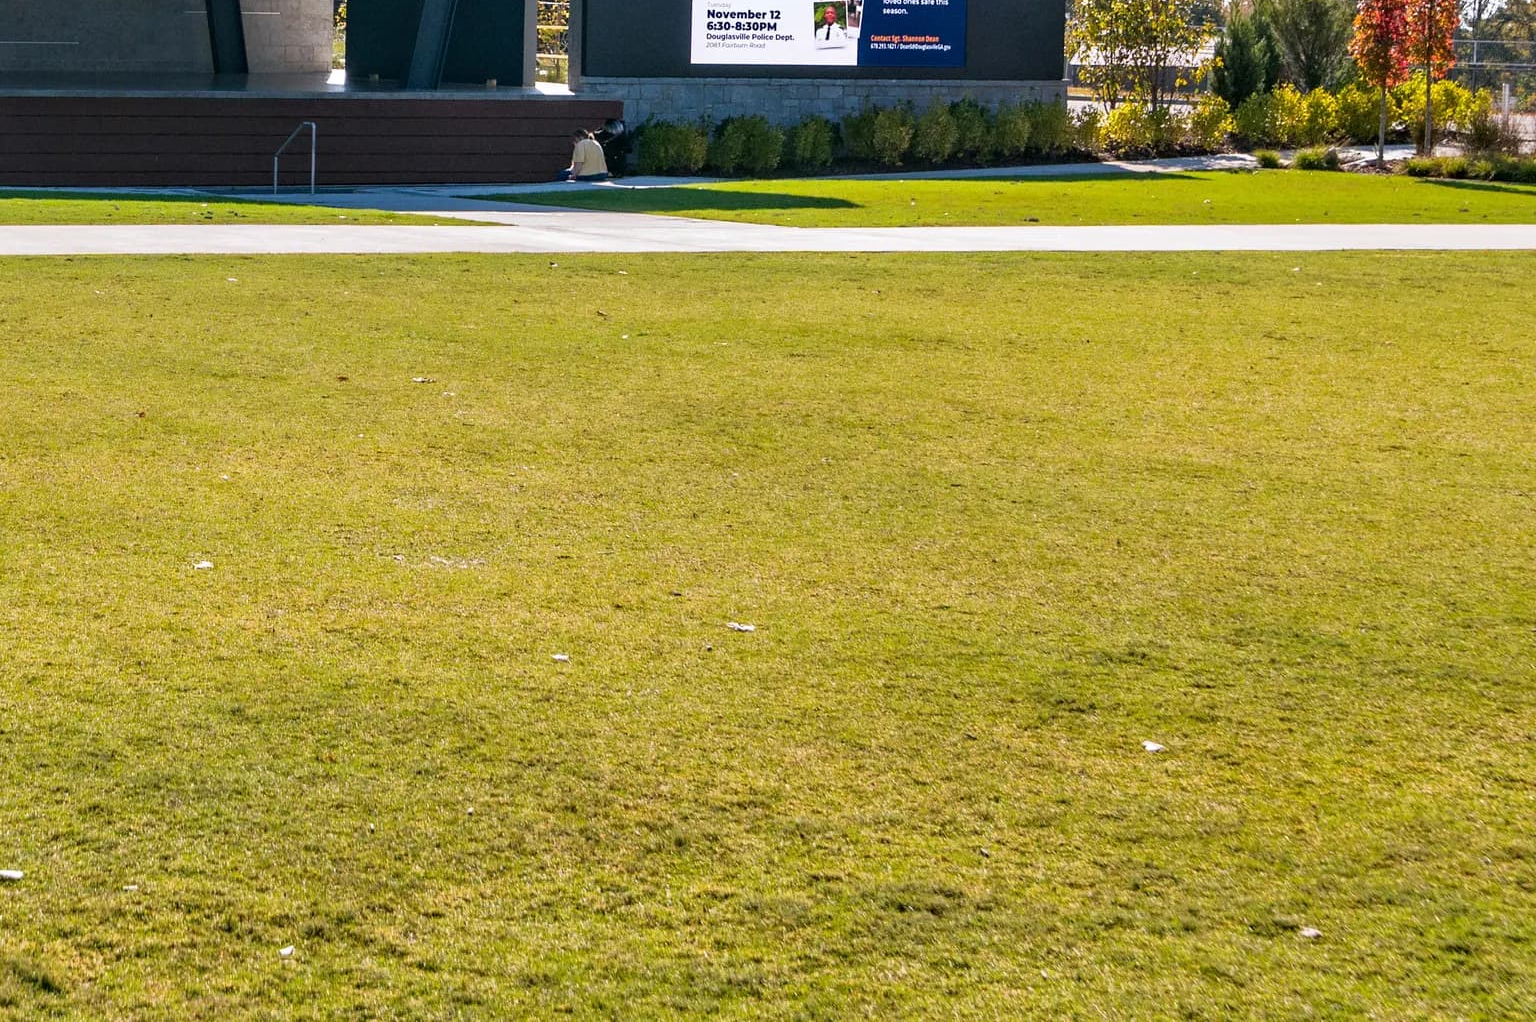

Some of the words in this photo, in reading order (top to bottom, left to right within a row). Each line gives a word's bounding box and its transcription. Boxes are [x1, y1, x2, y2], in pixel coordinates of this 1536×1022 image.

[707, 9, 767, 19] November
[769, 10, 781, 19] 12
[706, 21, 777, 31] 6:30-8:30PM
[706, 33, 750, 41] Douglasville
[752, 33, 774, 41] Police
[775, 34, 795, 42] Dept.
